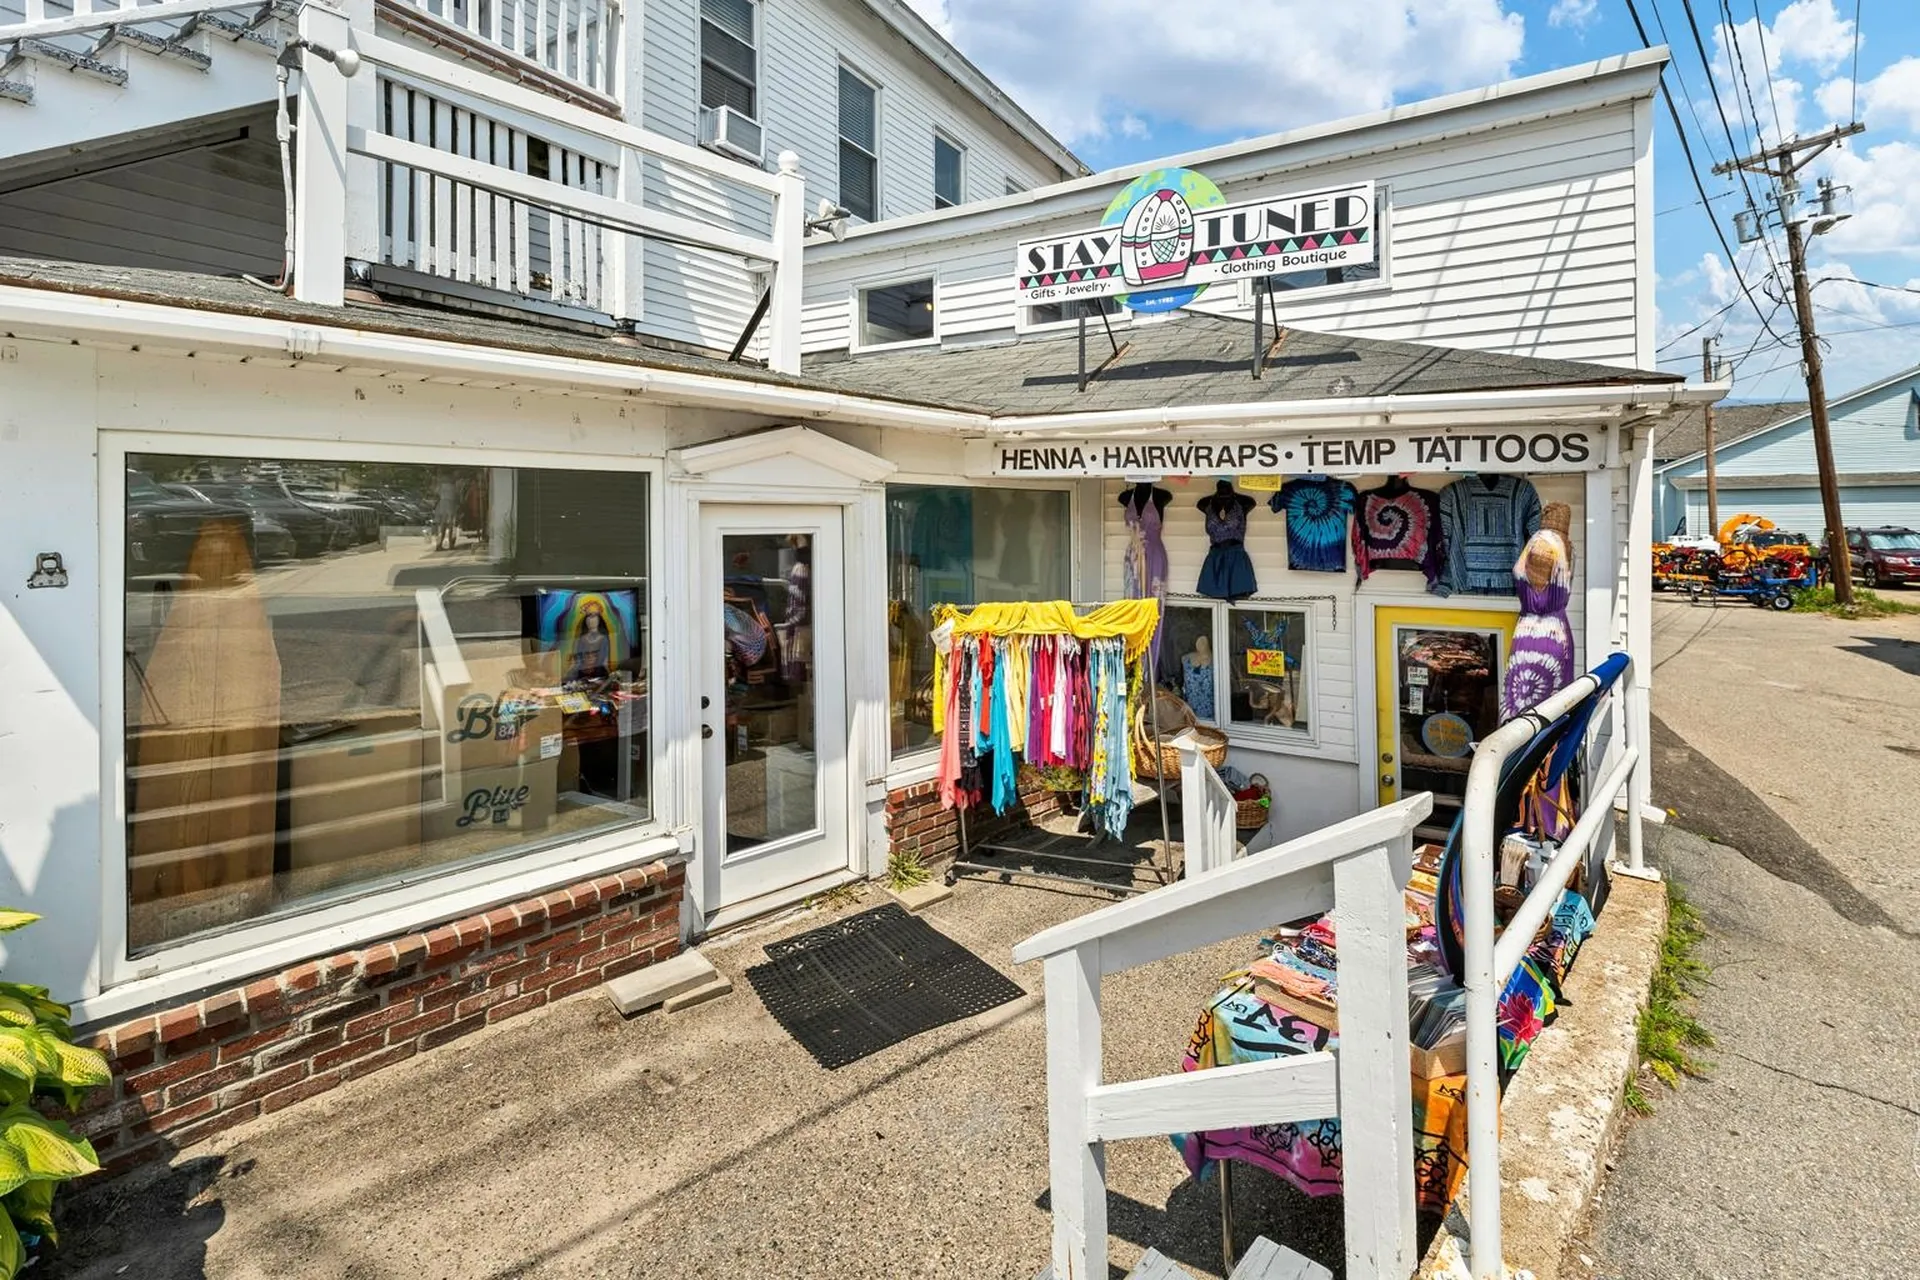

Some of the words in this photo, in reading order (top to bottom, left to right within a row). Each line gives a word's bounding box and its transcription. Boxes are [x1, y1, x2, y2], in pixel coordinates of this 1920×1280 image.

[1028, 233, 1118, 275] STAY
[1200, 195, 1368, 247] TUNED
[1030, 288, 1056, 300] Gifts
[1065, 281, 1107, 295] Jewelry
[1220, 258, 1276, 275] Clothing
[1282, 249, 1348, 267] Boutique
[1000, 446, 1087, 470] HENNA
[1102, 442, 1280, 469] HAIRWRAPS
[1301, 438, 1397, 467] TEMP
[1408, 433, 1590, 464] TATTOOS
[456, 785, 529, 827] Blue
